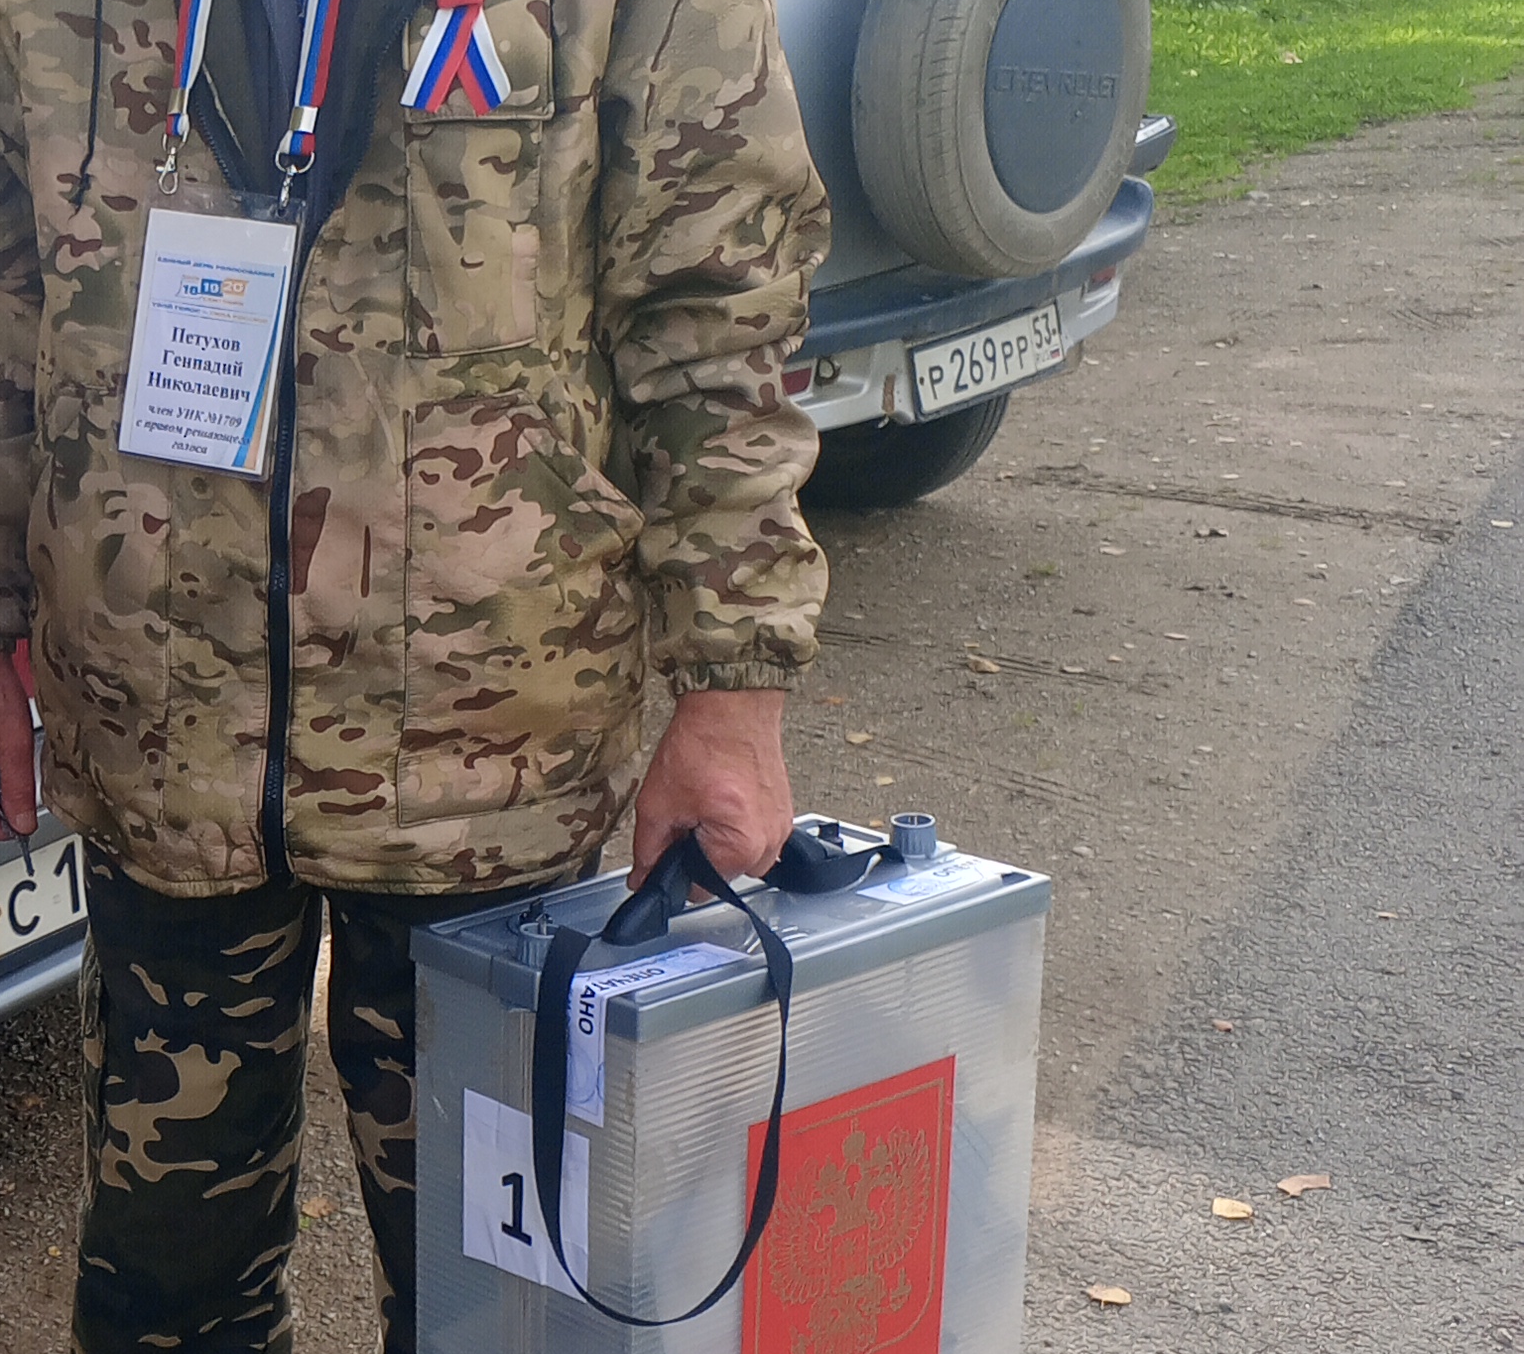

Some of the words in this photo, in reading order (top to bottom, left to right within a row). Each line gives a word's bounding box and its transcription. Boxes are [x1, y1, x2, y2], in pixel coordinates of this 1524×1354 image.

[171, 326, 241, 352] Петухов
[161, 349, 243, 377] Геннадий
[147, 371, 251, 403] Николаевич
[501, 1172, 532, 1247] 1
